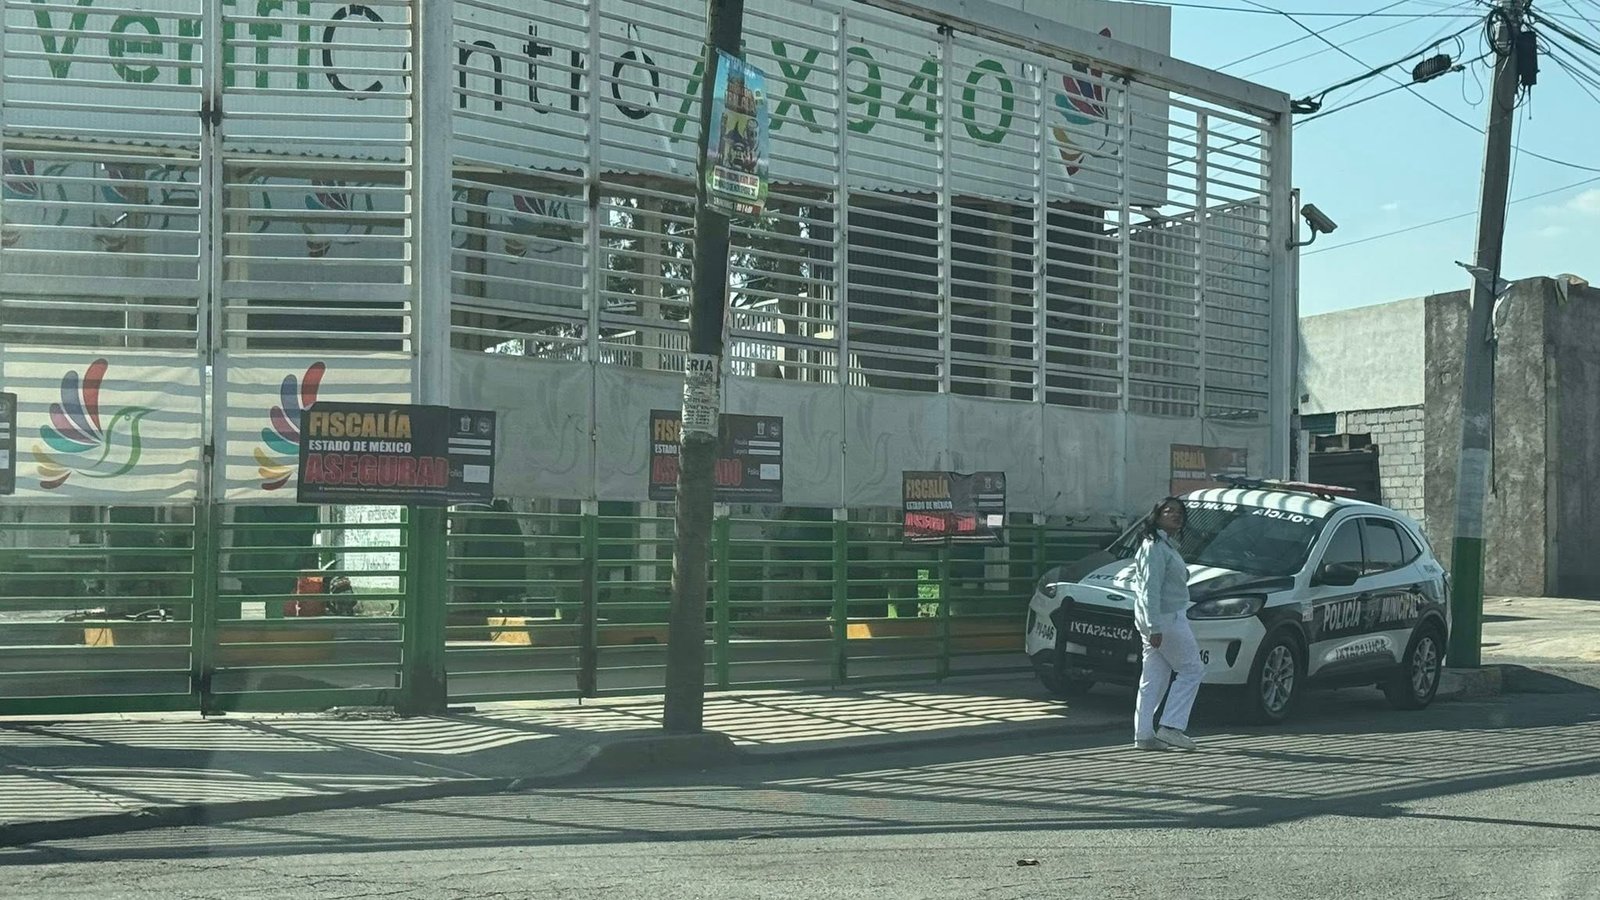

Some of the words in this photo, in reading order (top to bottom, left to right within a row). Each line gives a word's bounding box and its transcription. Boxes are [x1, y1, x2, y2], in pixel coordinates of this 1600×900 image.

[309, 409, 412, 438] FISCALÍA
[308, 440, 351, 452] ESTADO
[353, 441, 367, 452] DE
[369, 440, 412, 453] MÉXICO
[655, 444, 677, 454] ESTADO
[905, 476, 951, 498] FISCALÍA
